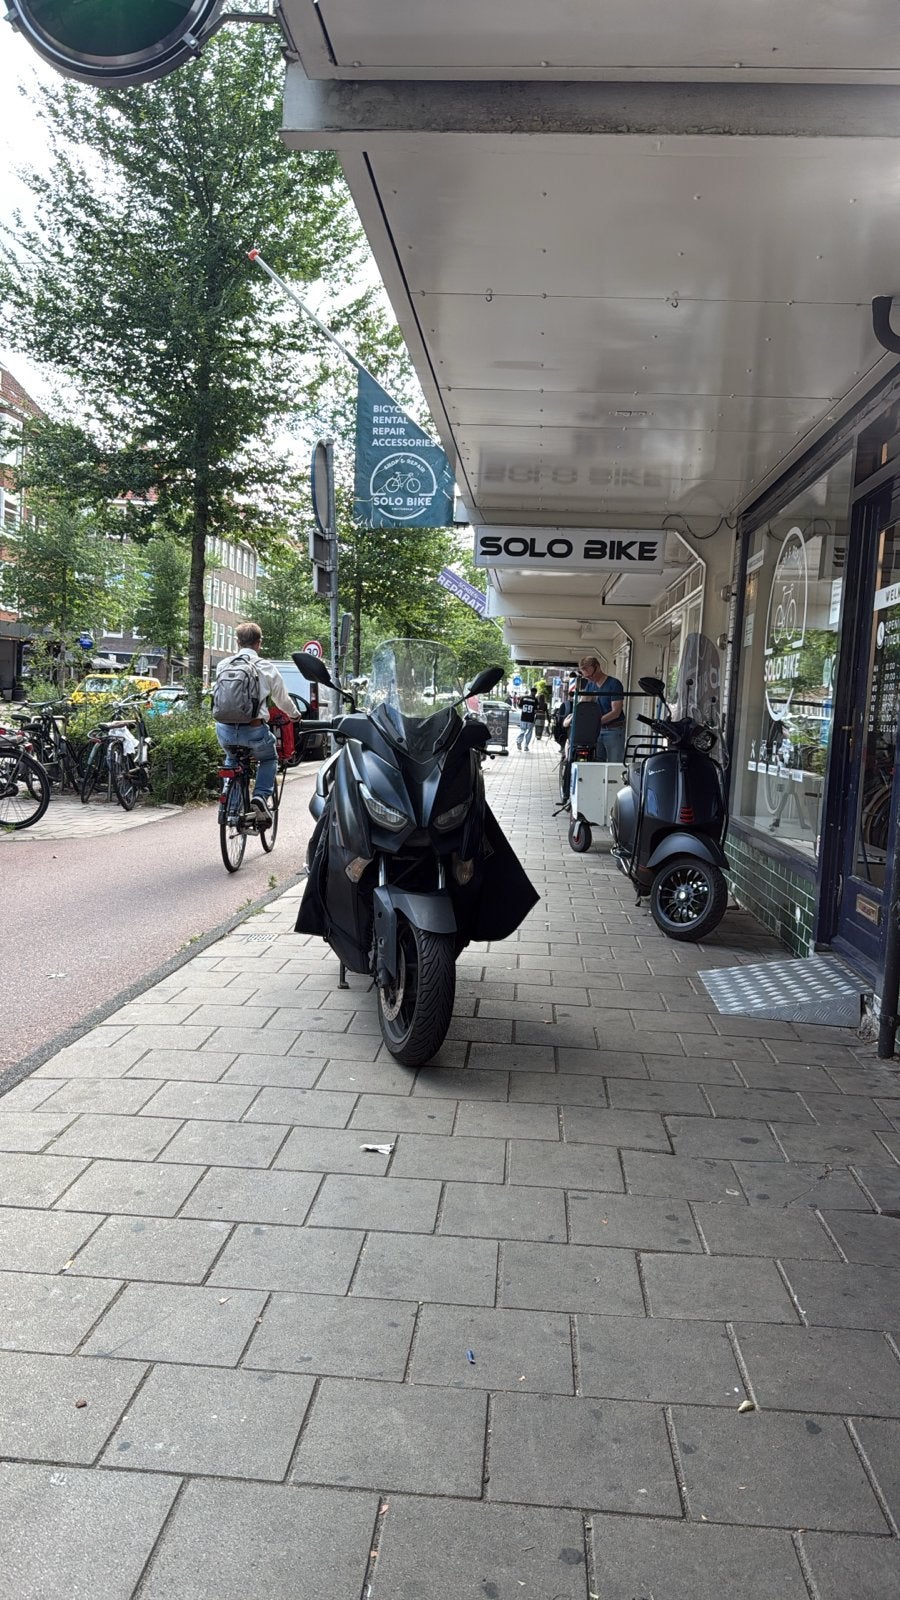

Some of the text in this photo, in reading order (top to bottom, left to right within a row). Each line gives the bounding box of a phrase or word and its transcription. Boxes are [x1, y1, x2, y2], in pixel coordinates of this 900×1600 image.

[373, 404, 402, 414] BICYC
[372, 416, 409, 425] RENTAL
[372, 427, 406, 436] REPAIR
[371, 438, 436, 447] ACCESSORIES
[406, 458, 426, 473] REPAIR
[373, 496, 433, 507] SOLO BIKE
[479, 536, 659, 562] SOLO BIKE
[437, 574, 486, 614] REPARATI
[764, 652, 800, 682] SOLO BIKE
